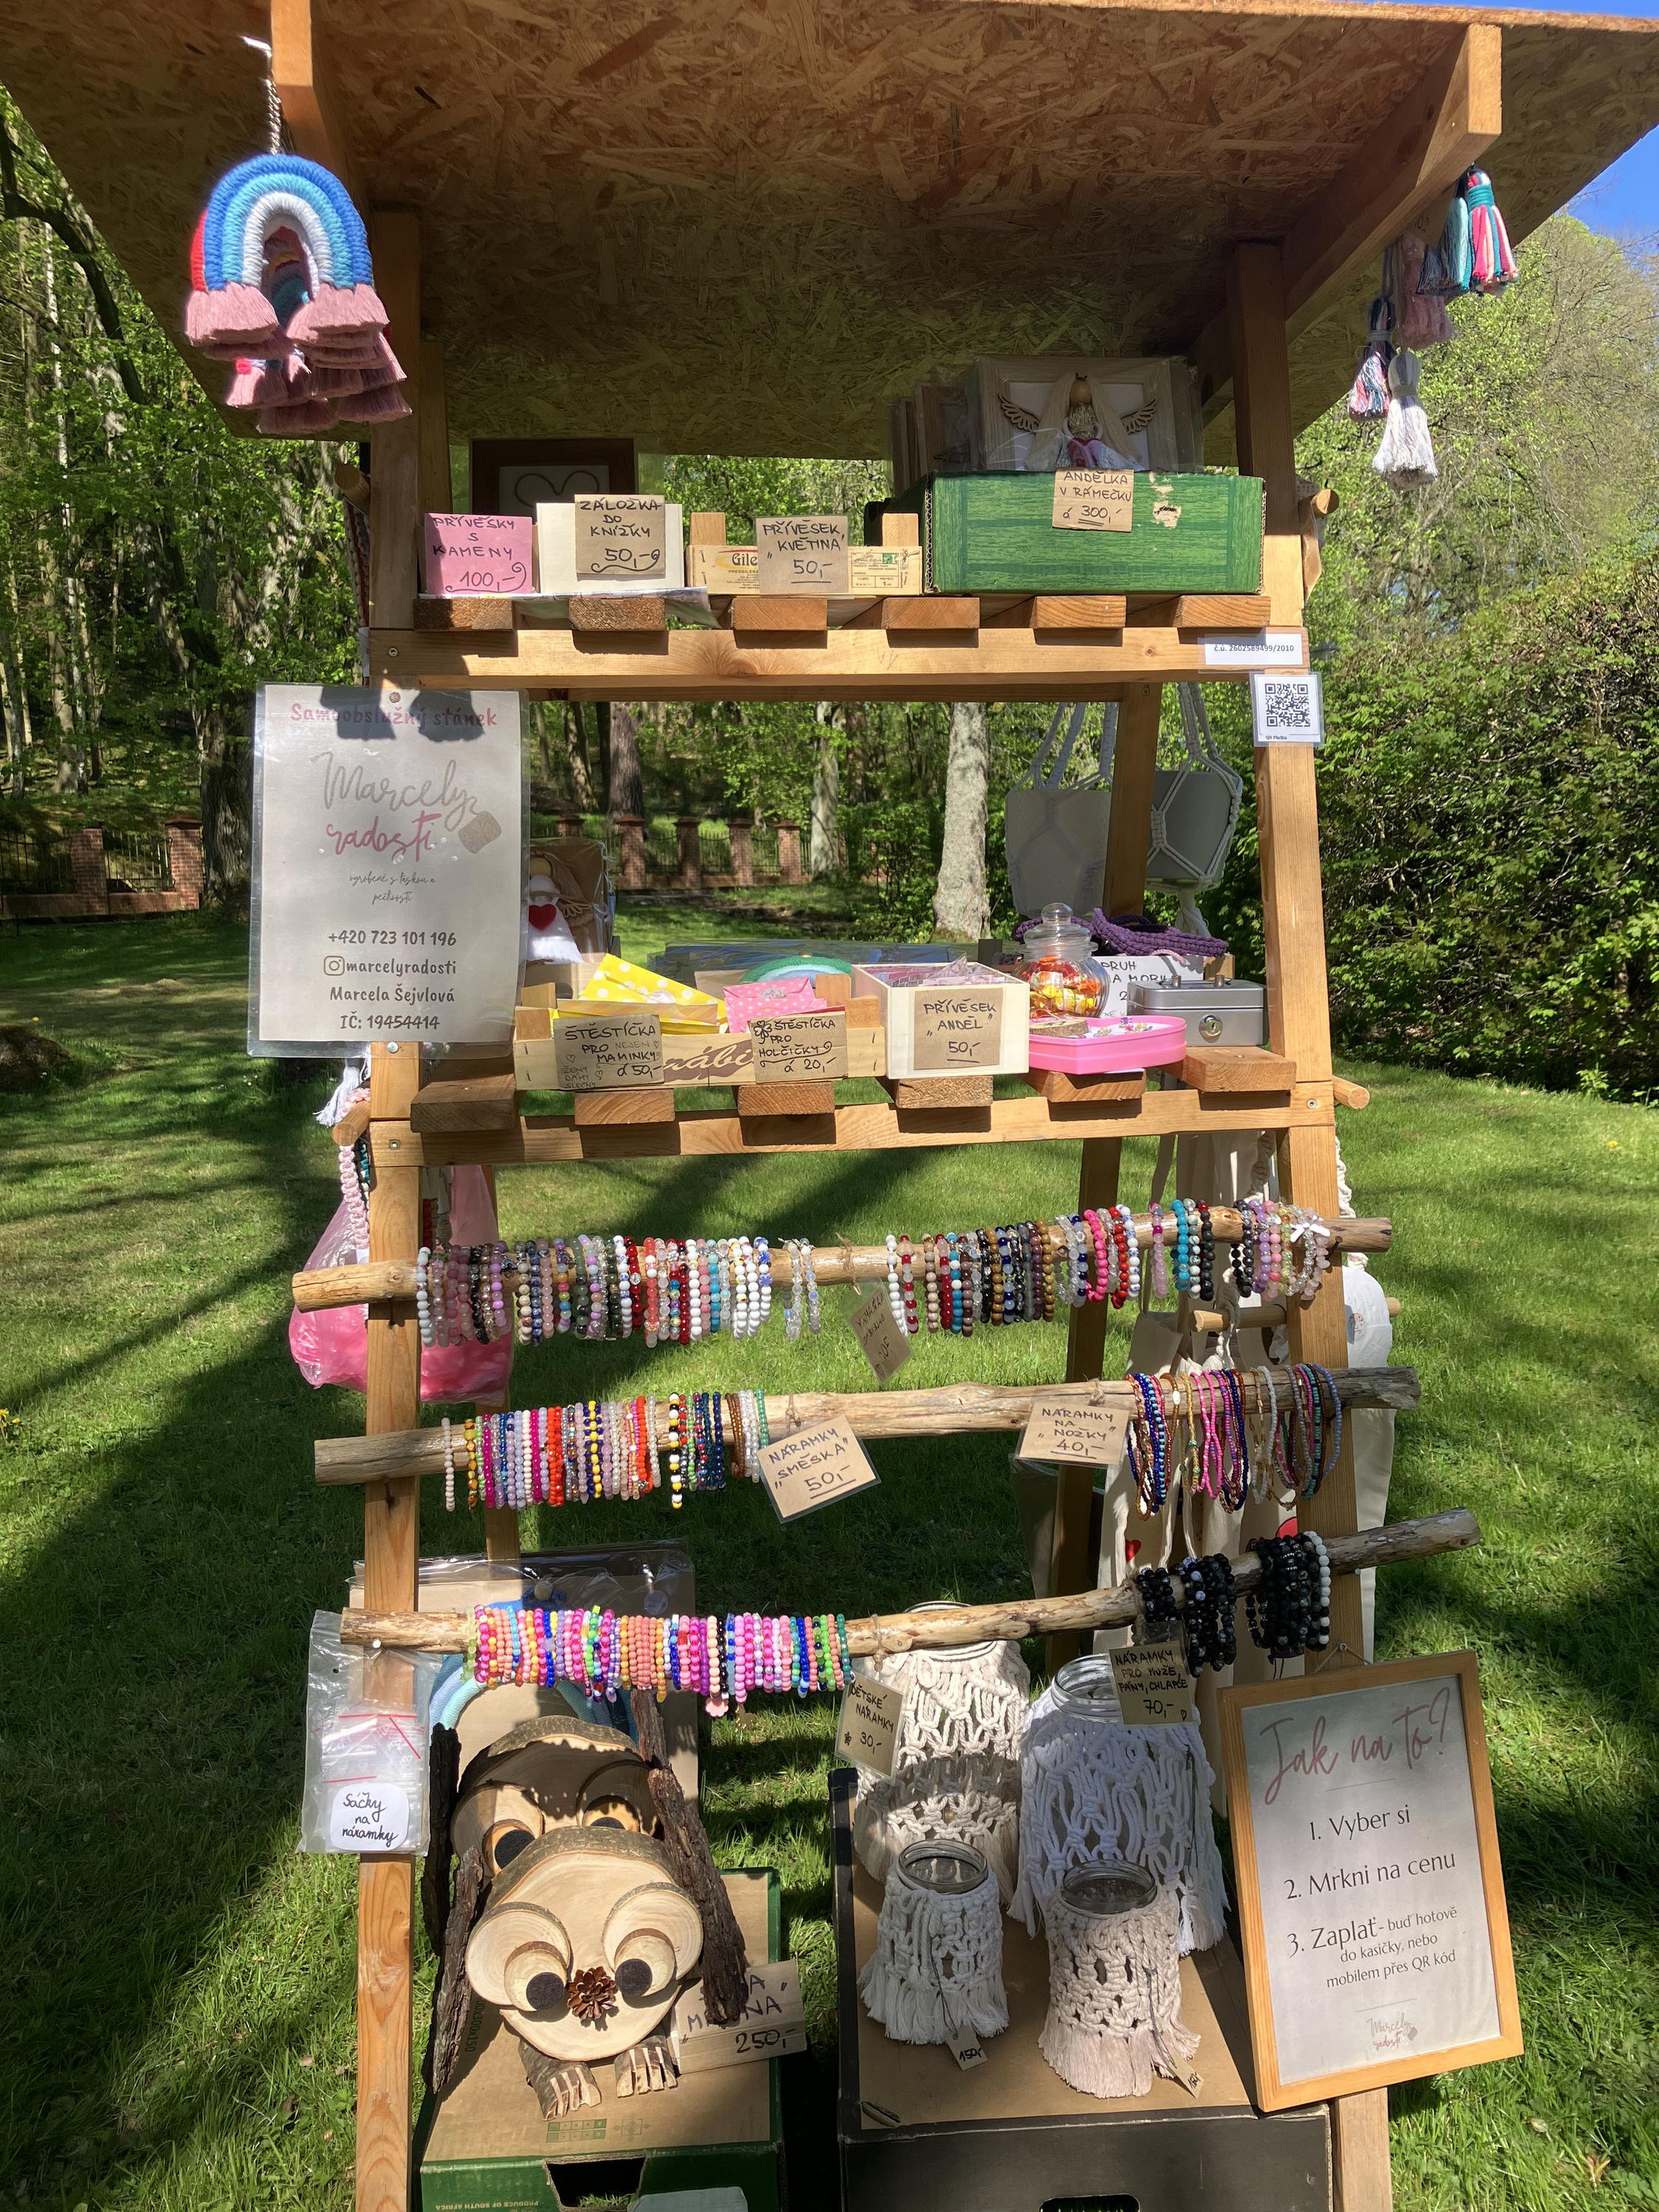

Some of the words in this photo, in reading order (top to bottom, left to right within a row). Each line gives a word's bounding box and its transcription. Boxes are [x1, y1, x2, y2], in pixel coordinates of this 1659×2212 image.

[1064, 470, 1127, 485] ANDĚLKA
[1060, 487, 1067, 496] V
[1073, 485, 1132, 502] RÁMEČKU
[580, 498, 662, 511] ZÁLOŽKA
[603, 515, 622, 523] DO
[762, 519, 841, 535] PŘÍVĚSEK
[468, 533, 479, 541] S
[591, 524, 650, 538] KNÍŽKY
[433, 545, 512, 560] KAMENY
[291, 703, 425, 728] Samoobslužný
[434, 708, 498, 727] stánek
[310, 751, 479, 832] Marcely
[326, 810, 442, 863] radosti
[328, 930, 366, 945] +420
[371, 931, 397, 945] 723
[402, 931, 425, 945] 101
[431, 931, 456, 947] 196
[347, 959, 456, 977] marcelyradosti
[330, 986, 390, 1002] Marcela
[394, 982, 455, 1005] Šejvlová
[923, 999, 997, 1015] PŘÍVĚSEK
[340, 1011, 362, 1029] IČ:
[366, 1015, 441, 1030] 19454414
[774, 1018, 836, 1031] ŠTĚSTÍČKA
[565, 1022, 655, 1040] ŠTĚSTÍČKA
[770, 1035, 792, 1043] PRO
[582, 1043, 609, 1054] PRO
[615, 1040, 650, 1049] NEJEN
[759, 1045, 819, 1058] HOLČIČKY
[597, 1051, 655, 1062] MAMINKY
[1042, 1407, 1113, 1422] NÁRAMKY
[768, 1428, 840, 1464] NÁRAMKY
[1115, 1649, 1174, 1666] NÁRAMKY
[1121, 1668, 1142, 1679] PRO
[851, 1684, 888, 1709] DĚTSKÉ
[855, 1703, 894, 1733] NÁRAMKY
[1259, 1715, 1339, 1806] Jak
[1351, 1734, 1393, 1763] na
[343, 1792, 387, 1823] Sáčky
[355, 1815, 371, 1825] na
[1310, 1821, 1322, 1841] 1.
[1329, 1811, 1391, 1841] Vyber
[1397, 1804, 1410, 1825] si
[342, 1825, 399, 1848] náramky
[1284, 1879, 1302, 1899] 2.
[1309, 1865, 1370, 1896] Mrkni
[1377, 1864, 1400, 1882] na
[1408, 1852, 1456, 1876] cenu
[1287, 1933, 1305, 1958] 3.
[1311, 1916, 1378, 1951] Zaplať
[1416, 1906, 1458, 1926] hotově
[1340, 1949, 1357, 1964] do
[1360, 1940, 1405, 1961] kasičky,
[1408, 1933, 1438, 1952] nebo
[1326, 1968, 1380, 1989] mobilem
[1383, 1963, 1409, 1980] přes
[1411, 1954, 1431, 1972] QR
[1433, 1949, 1457, 1965] kód
